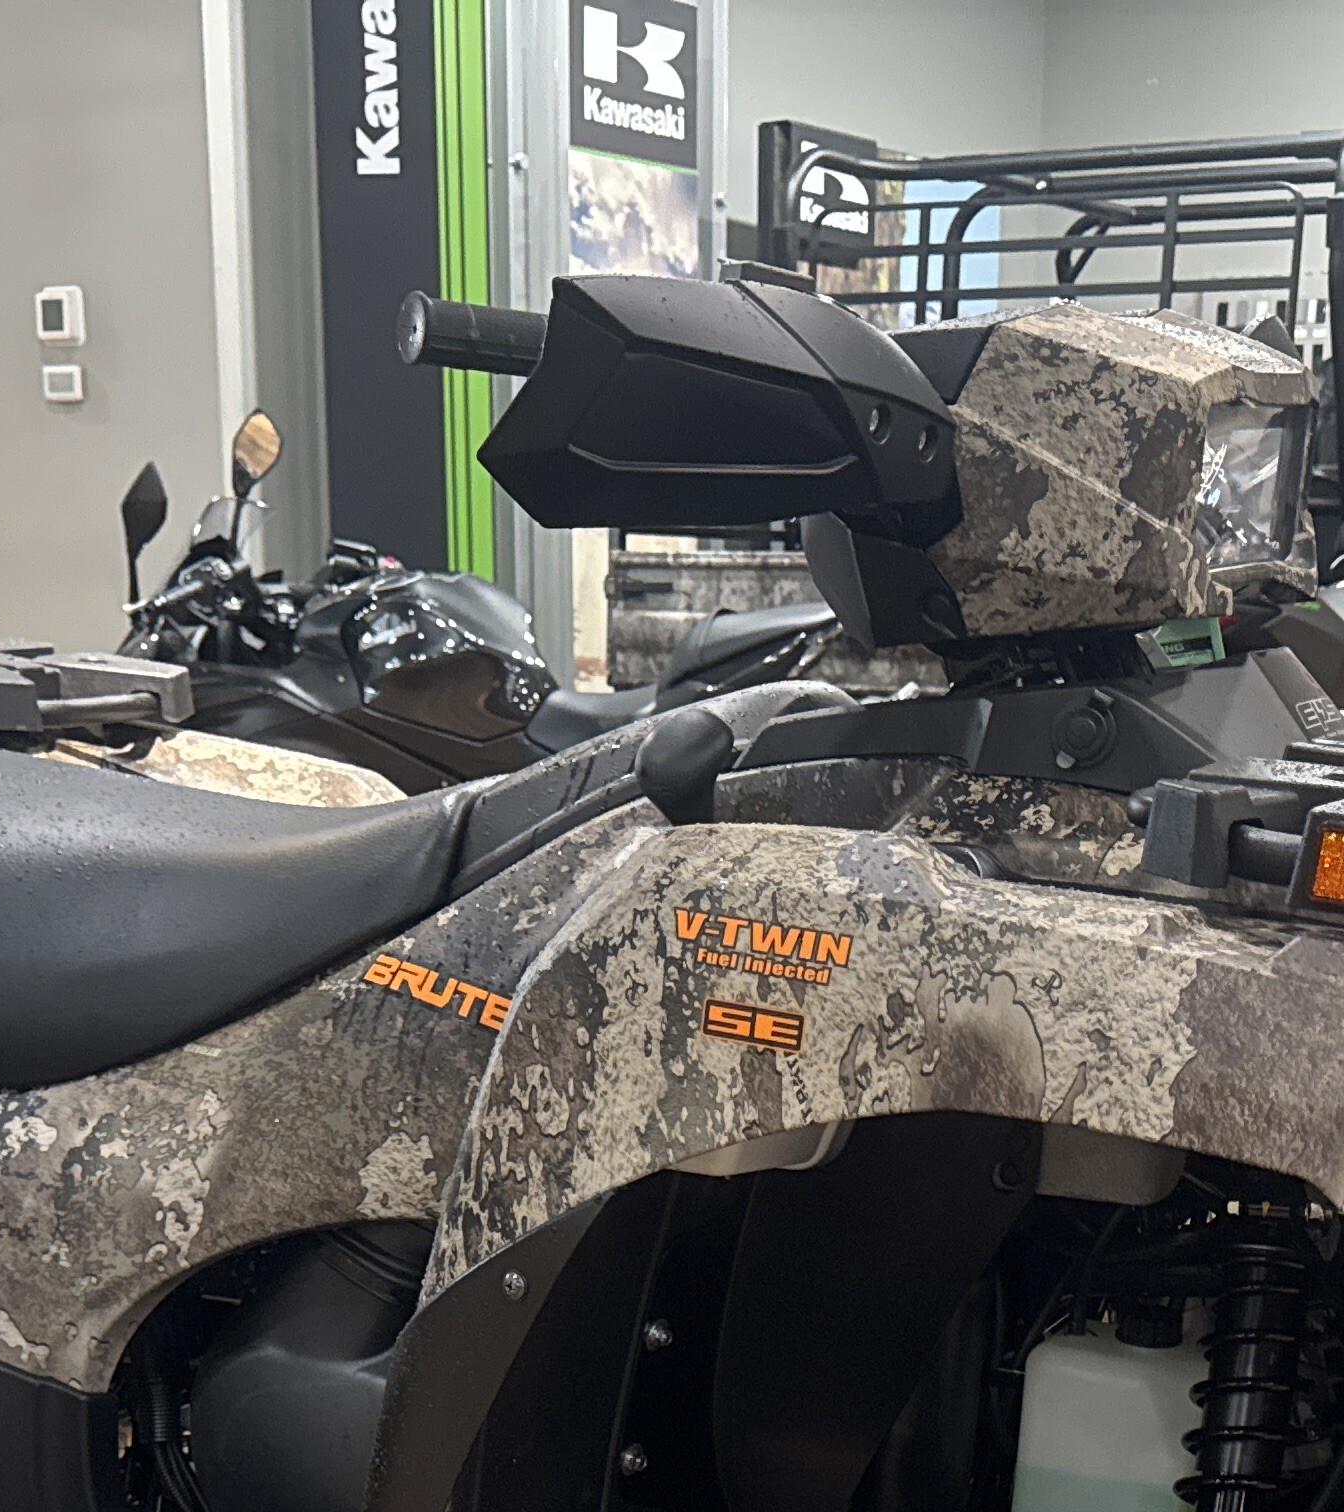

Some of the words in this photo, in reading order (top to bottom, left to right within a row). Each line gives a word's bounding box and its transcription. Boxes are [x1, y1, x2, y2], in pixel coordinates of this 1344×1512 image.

[583, 84, 685, 141] Kawasaki
[675, 908, 853, 967] V-TWIN
[363, 953, 514, 1032] BRUTE
[697, 947, 738, 971] Fuel
[742, 954, 832, 986] Injected
[705, 1002, 802, 1048] SE
